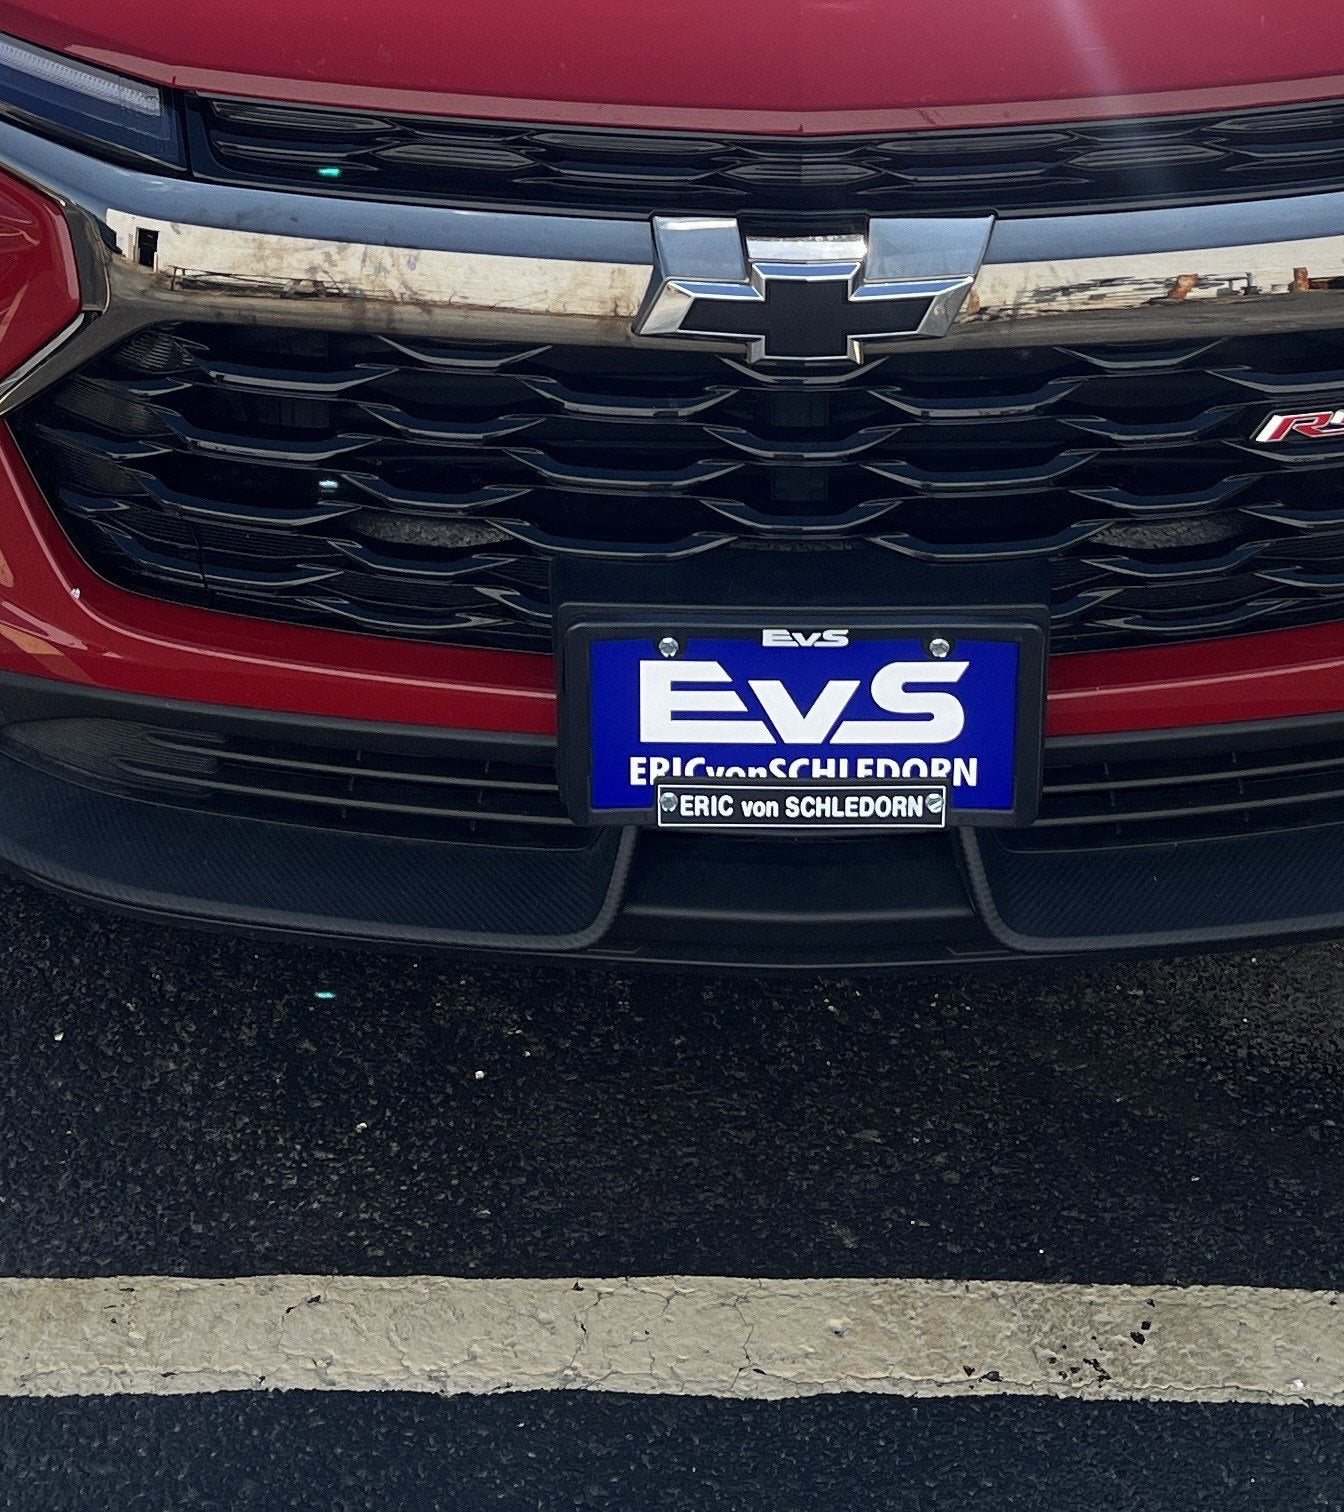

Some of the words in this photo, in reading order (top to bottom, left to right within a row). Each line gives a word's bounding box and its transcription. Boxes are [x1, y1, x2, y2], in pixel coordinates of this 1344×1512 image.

[680, 794, 734, 817] ERIC
[741, 800, 779, 818] von
[785, 794, 923, 818] SCHLEDORN
